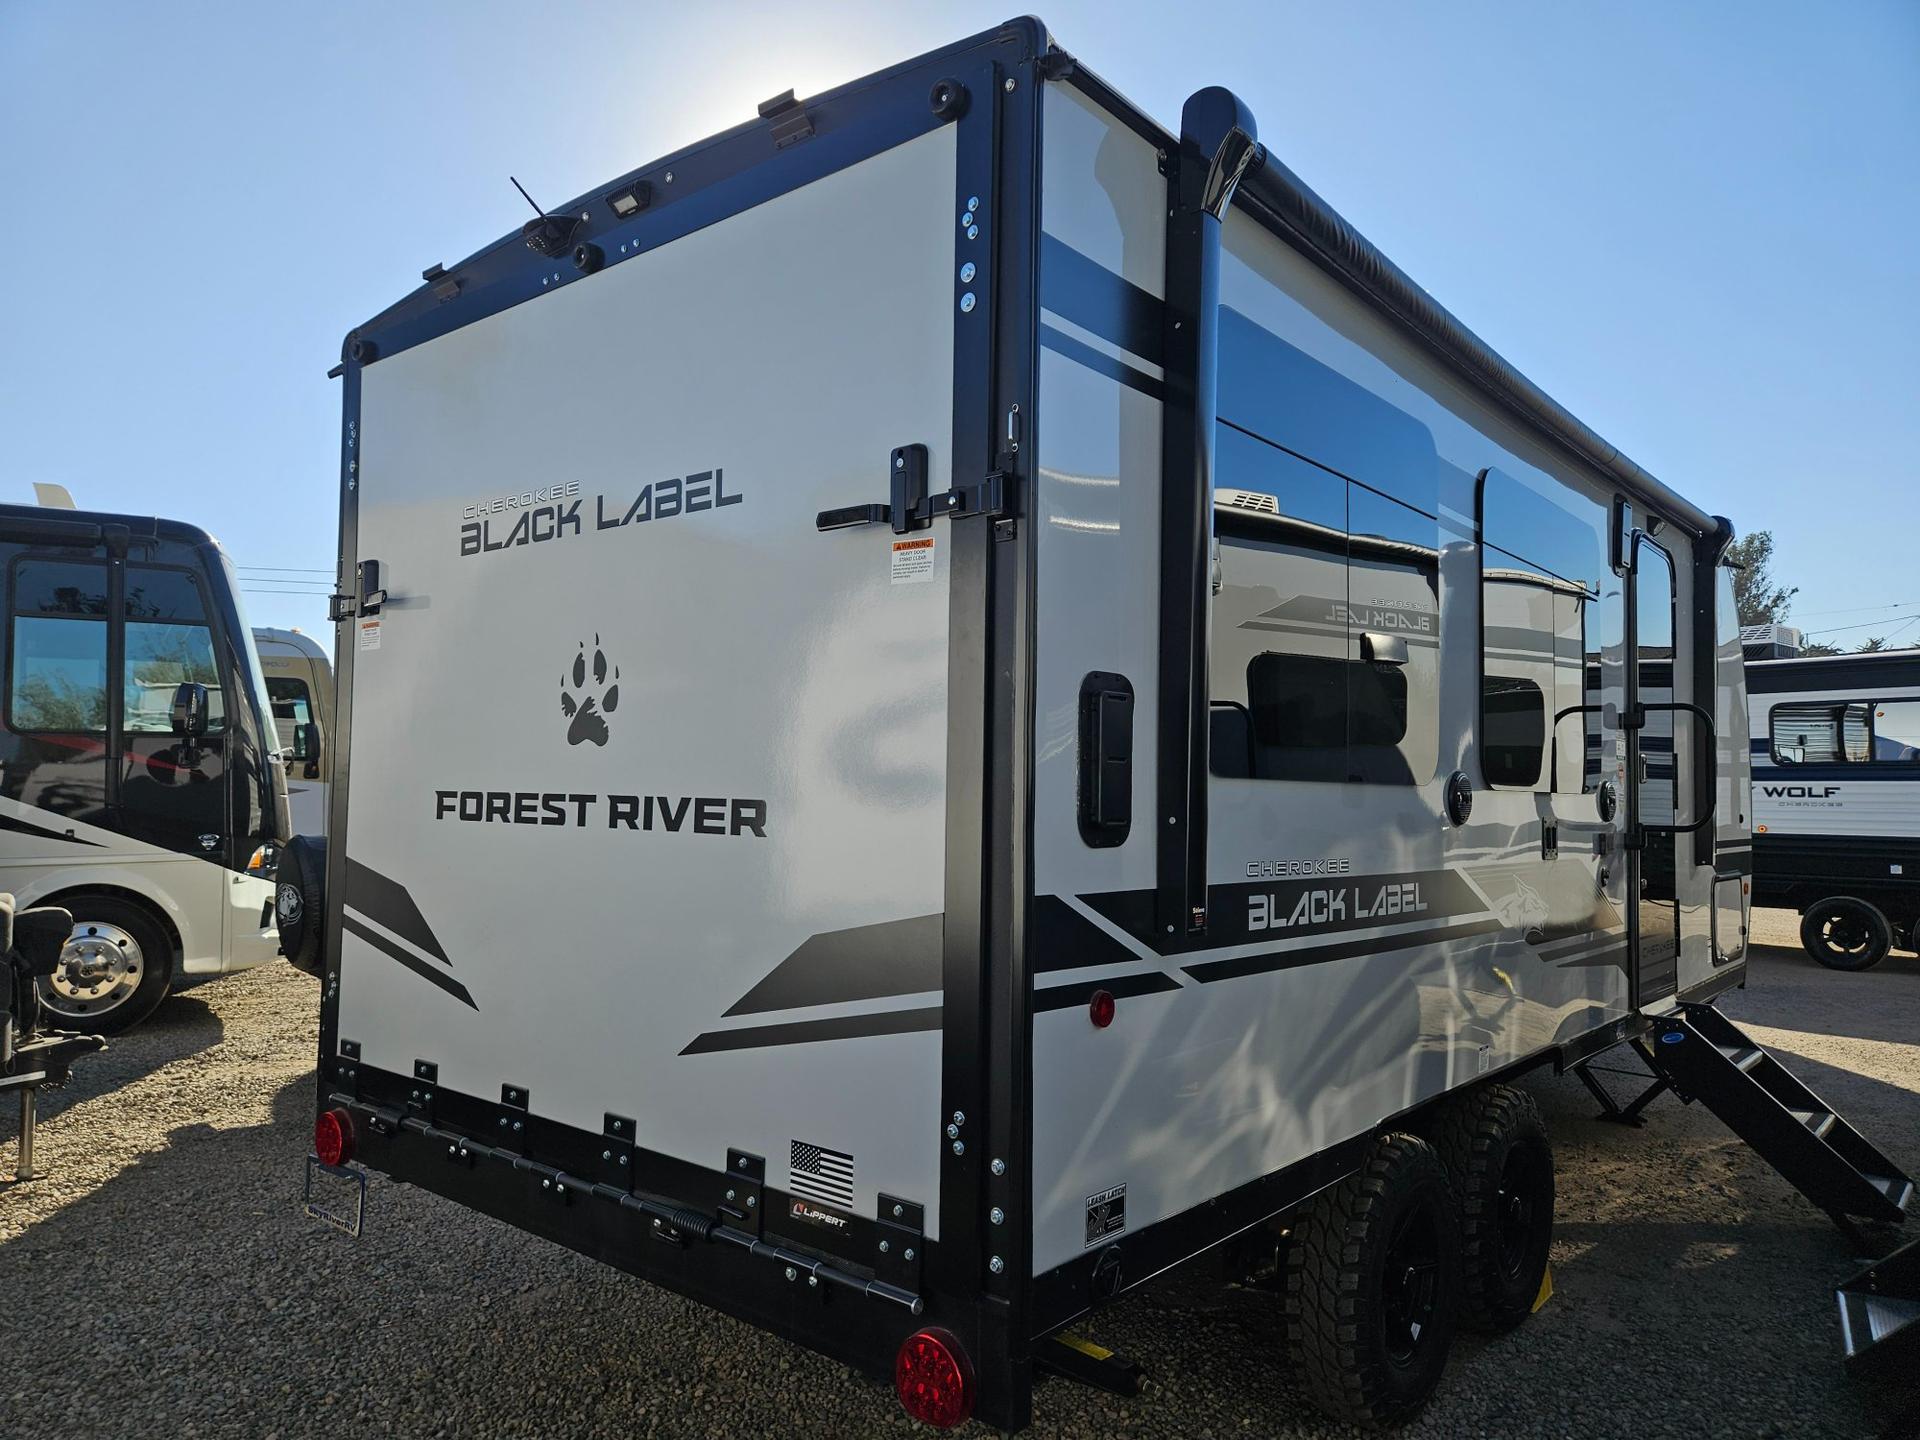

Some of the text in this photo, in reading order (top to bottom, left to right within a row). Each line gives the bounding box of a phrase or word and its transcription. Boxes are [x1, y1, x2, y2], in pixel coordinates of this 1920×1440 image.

[461, 468, 743, 556] BLACK LABEL
[463, 480, 581, 519] CHEROKEE
[901, 539, 931, 549] WARNING
[1763, 786, 1841, 798] WOLF
[435, 790, 767, 837] FOREST RIVER
[1246, 858, 1350, 877] CHEROKEE
[1248, 882, 1428, 931] BLACK LABEL
